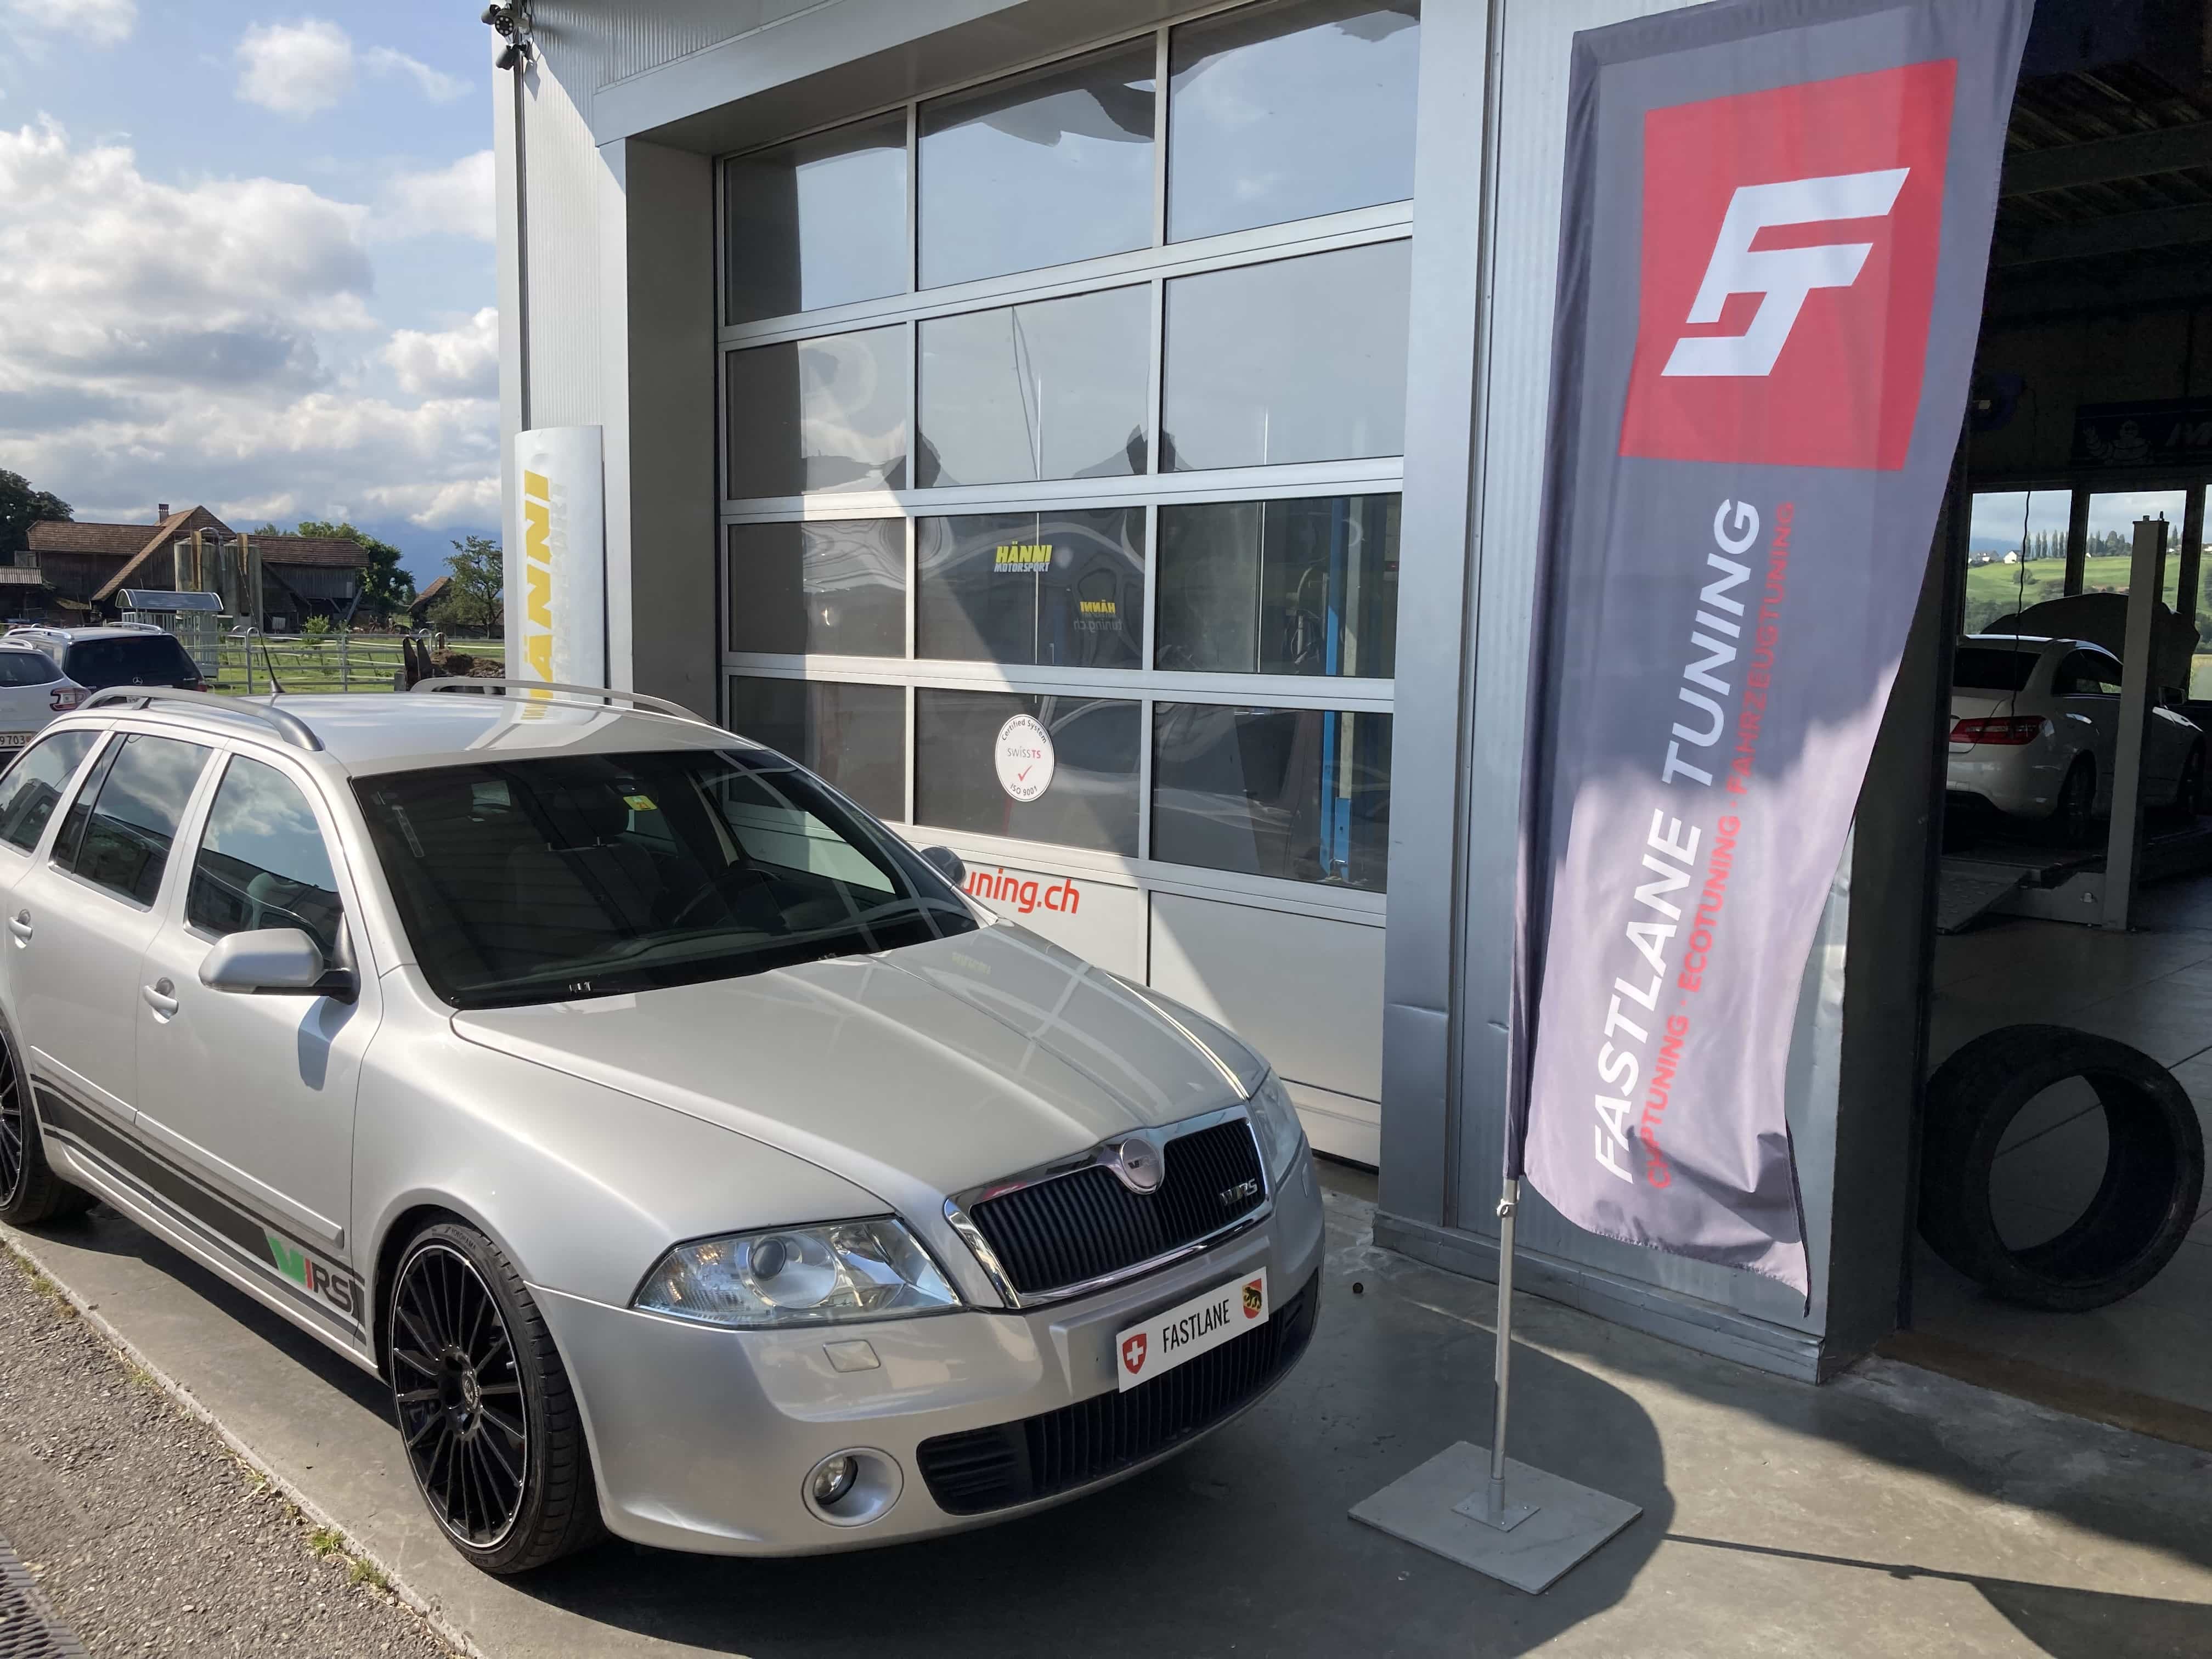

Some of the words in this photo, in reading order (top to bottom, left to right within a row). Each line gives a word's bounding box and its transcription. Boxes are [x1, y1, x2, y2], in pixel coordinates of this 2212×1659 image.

[994, 562, 1050, 572] MOTORSPORT
[996, 540, 1052, 563] HÄNNI
[523, 469, 554, 699] ÄNNI
[1002, 719, 1025, 741] Certified
[1028, 719, 1047, 743] System
[1678, 815, 1741, 992] ECOTUNING
[1726, 501, 1795, 794] FAHRZEUGTUNING
[1011, 783, 1021, 794] ISO
[1023, 785, 1037, 795] 9001
[1595, 808, 1701, 1184] FASTLANE
[1662, 499, 1759, 786] TUNING
[1163, 1299, 1230, 1353] FASTLANE
